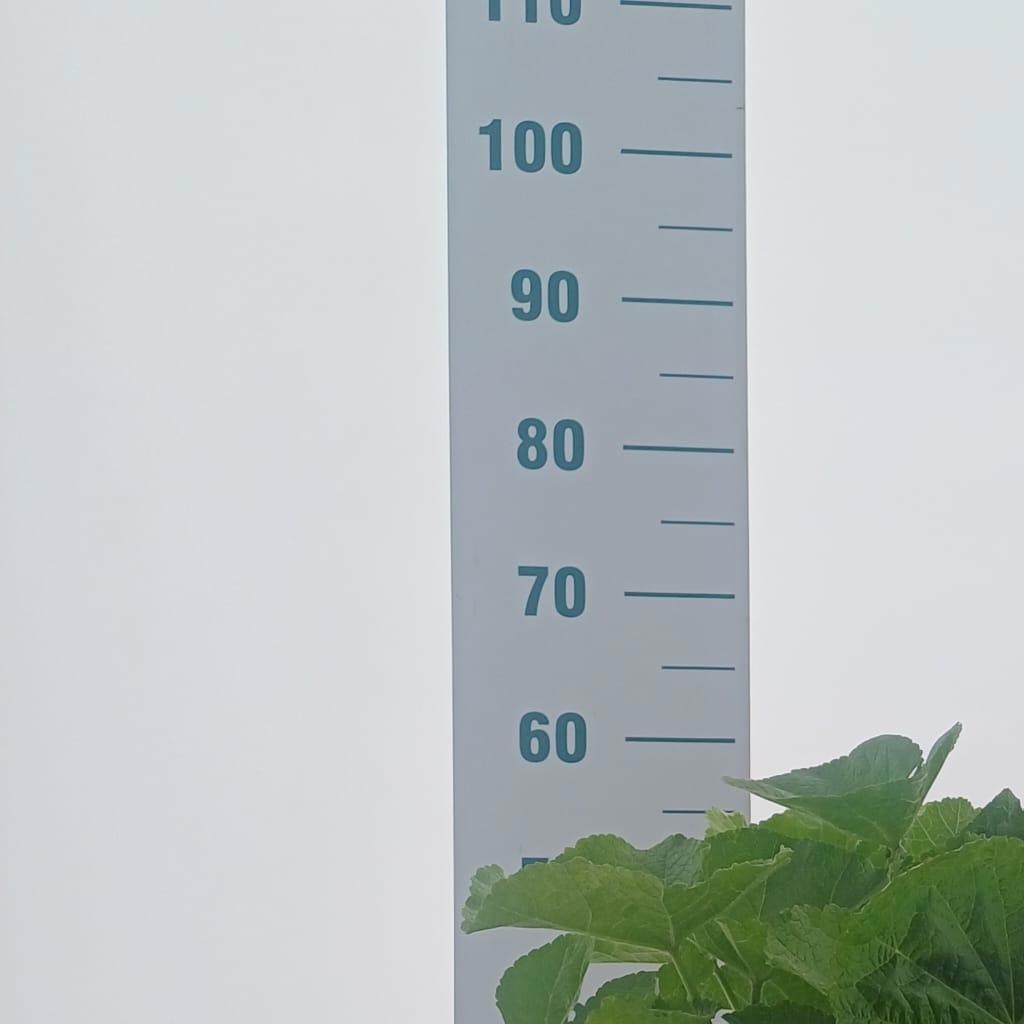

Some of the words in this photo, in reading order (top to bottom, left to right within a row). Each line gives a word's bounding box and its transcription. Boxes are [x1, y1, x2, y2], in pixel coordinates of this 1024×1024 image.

[478, 118, 583, 175] 100
[510, 268, 580, 323] 90
[516, 417, 586, 472] 80
[517, 565, 587, 618] 70
[518, 711, 588, 764] 60
